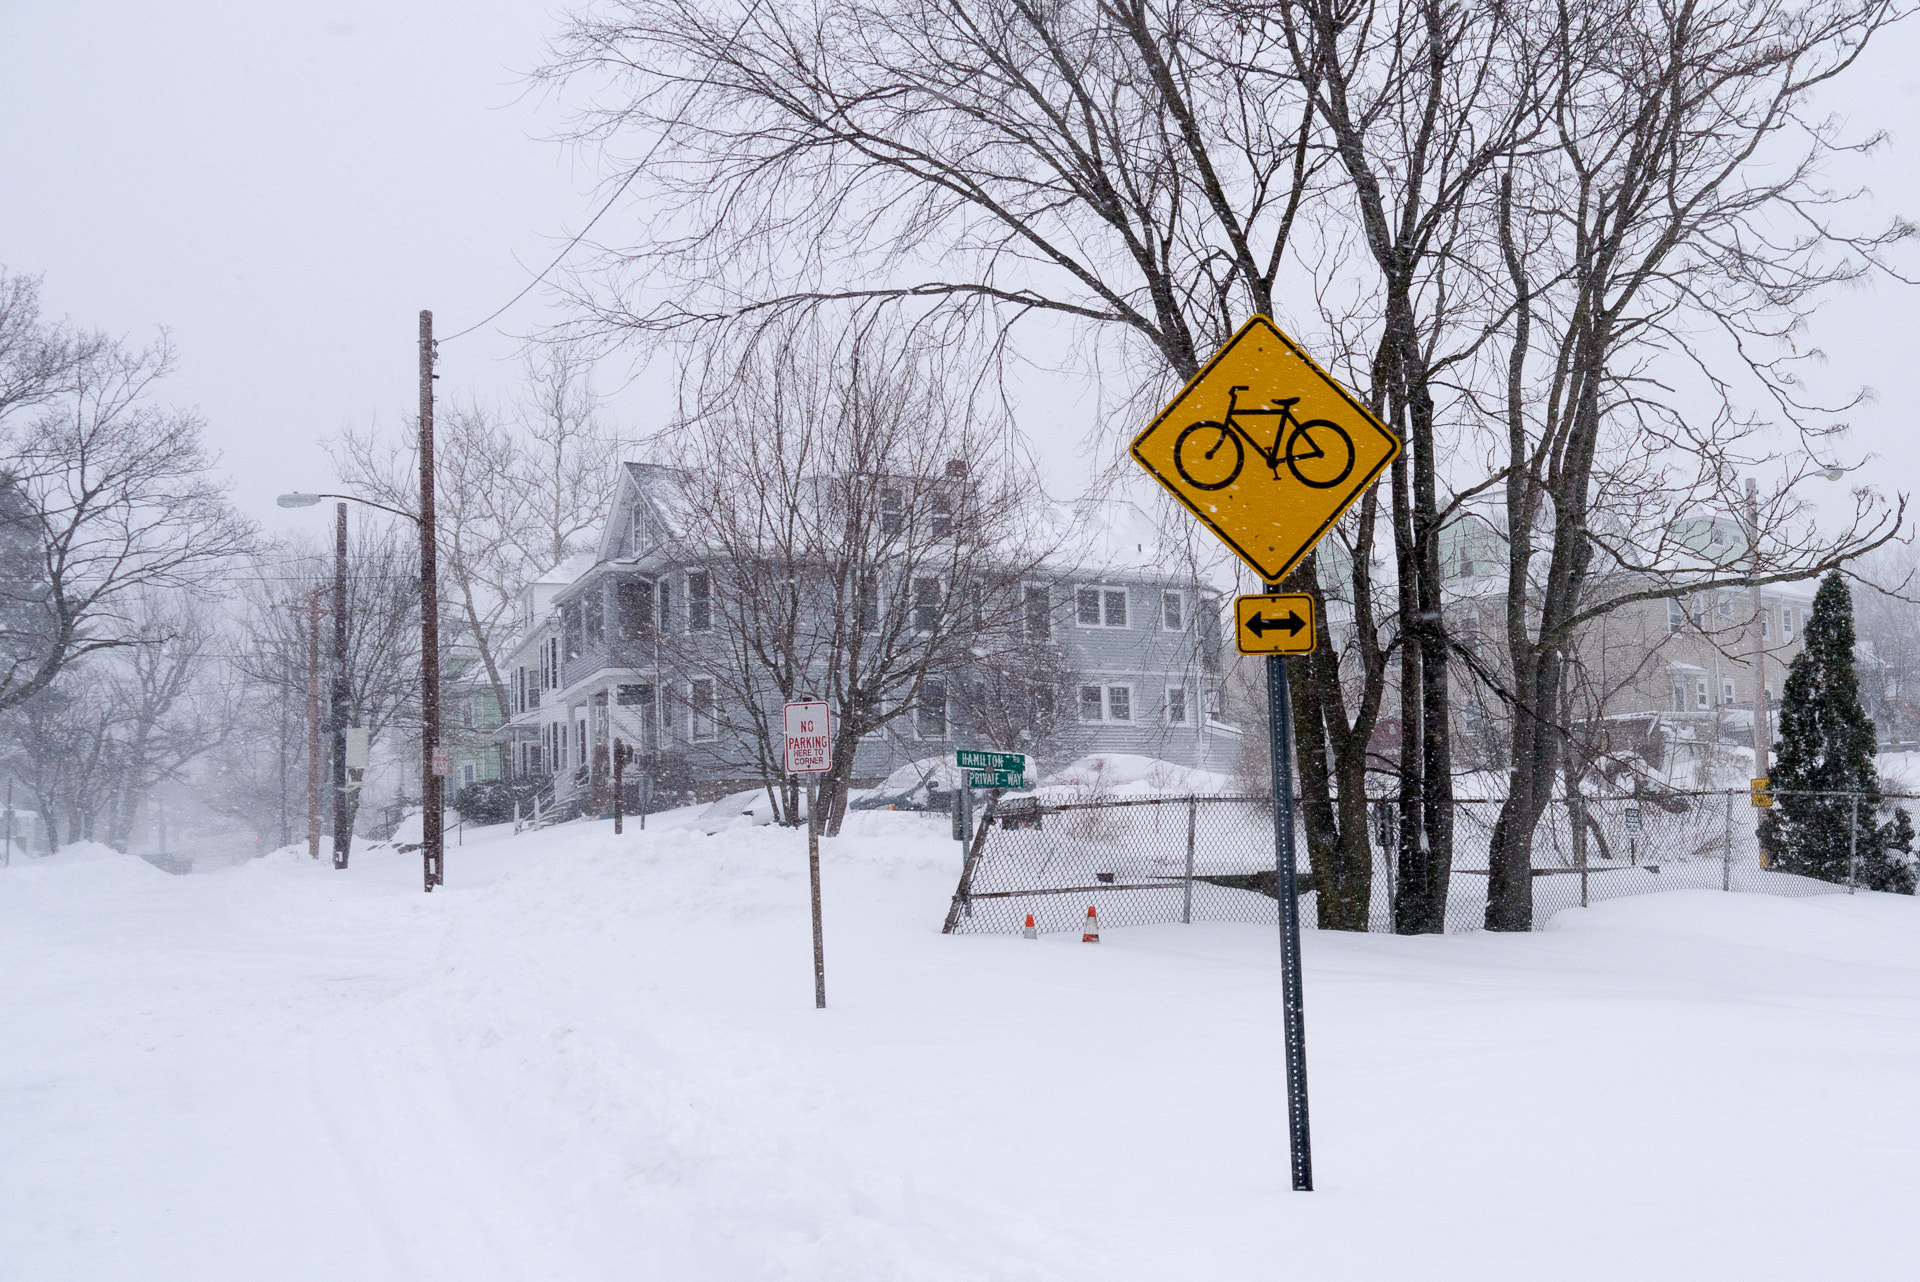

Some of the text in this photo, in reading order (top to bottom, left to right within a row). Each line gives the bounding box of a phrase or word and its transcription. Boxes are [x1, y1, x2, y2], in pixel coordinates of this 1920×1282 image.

[800, 720, 814, 733] NO
[788, 736, 828, 750] PARKING
[793, 748, 824, 758] HERE TO
[794, 756, 824, 766] CORNER
[961, 752, 1004, 768] HAMILTON
[969, 772, 1001, 786] PRIVATE
[1006, 772, 1022, 786] WAY
